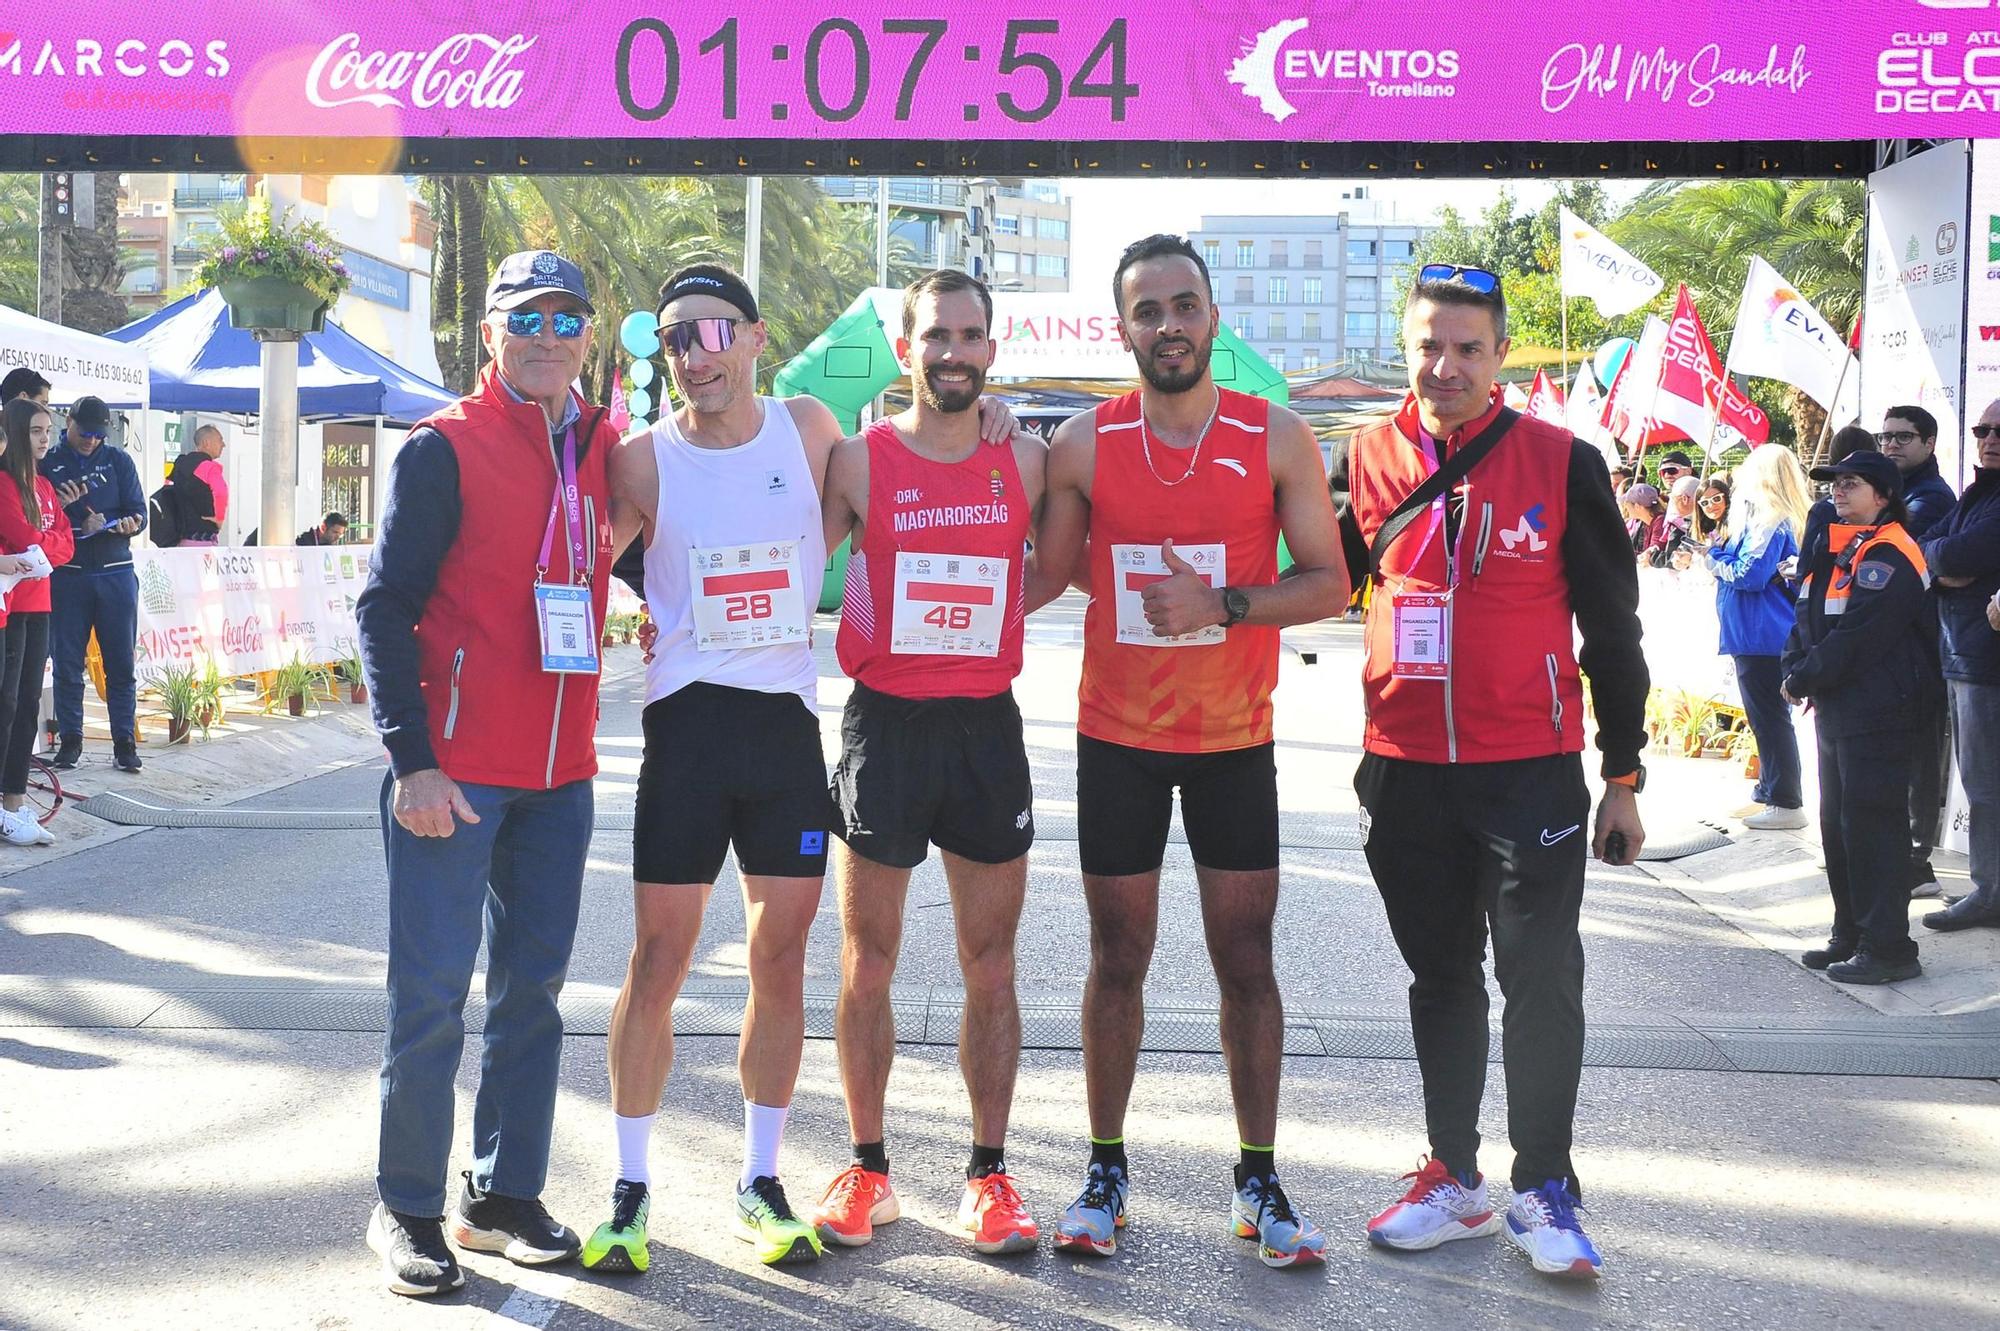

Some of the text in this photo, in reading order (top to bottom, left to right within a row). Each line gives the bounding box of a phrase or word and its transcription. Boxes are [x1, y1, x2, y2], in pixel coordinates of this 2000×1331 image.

[1891, 32, 1948, 46] CLUB
[305, 32, 540, 109] Coca-Cola
[615, 18, 1140, 123] 01:07:54
[1283, 50, 1460, 78] EVENTOS
[1625, 46, 1687, 102] My
[1687, 43, 1812, 107] Sandals
[1367, 80, 1456, 97] Torrellano
[533, 274, 563, 283] BRITISH
[40, 353, 69, 373] SILLAS
[95, 361, 110, 380] 615
[112, 365, 121, 381] 30
[133, 368, 143, 384] 62
[893, 499, 1008, 532] MAGYARORSZÁG
[726, 594, 772, 622] 28
[923, 605, 972, 630] 48
[286, 621, 316, 637] EVENTOS
